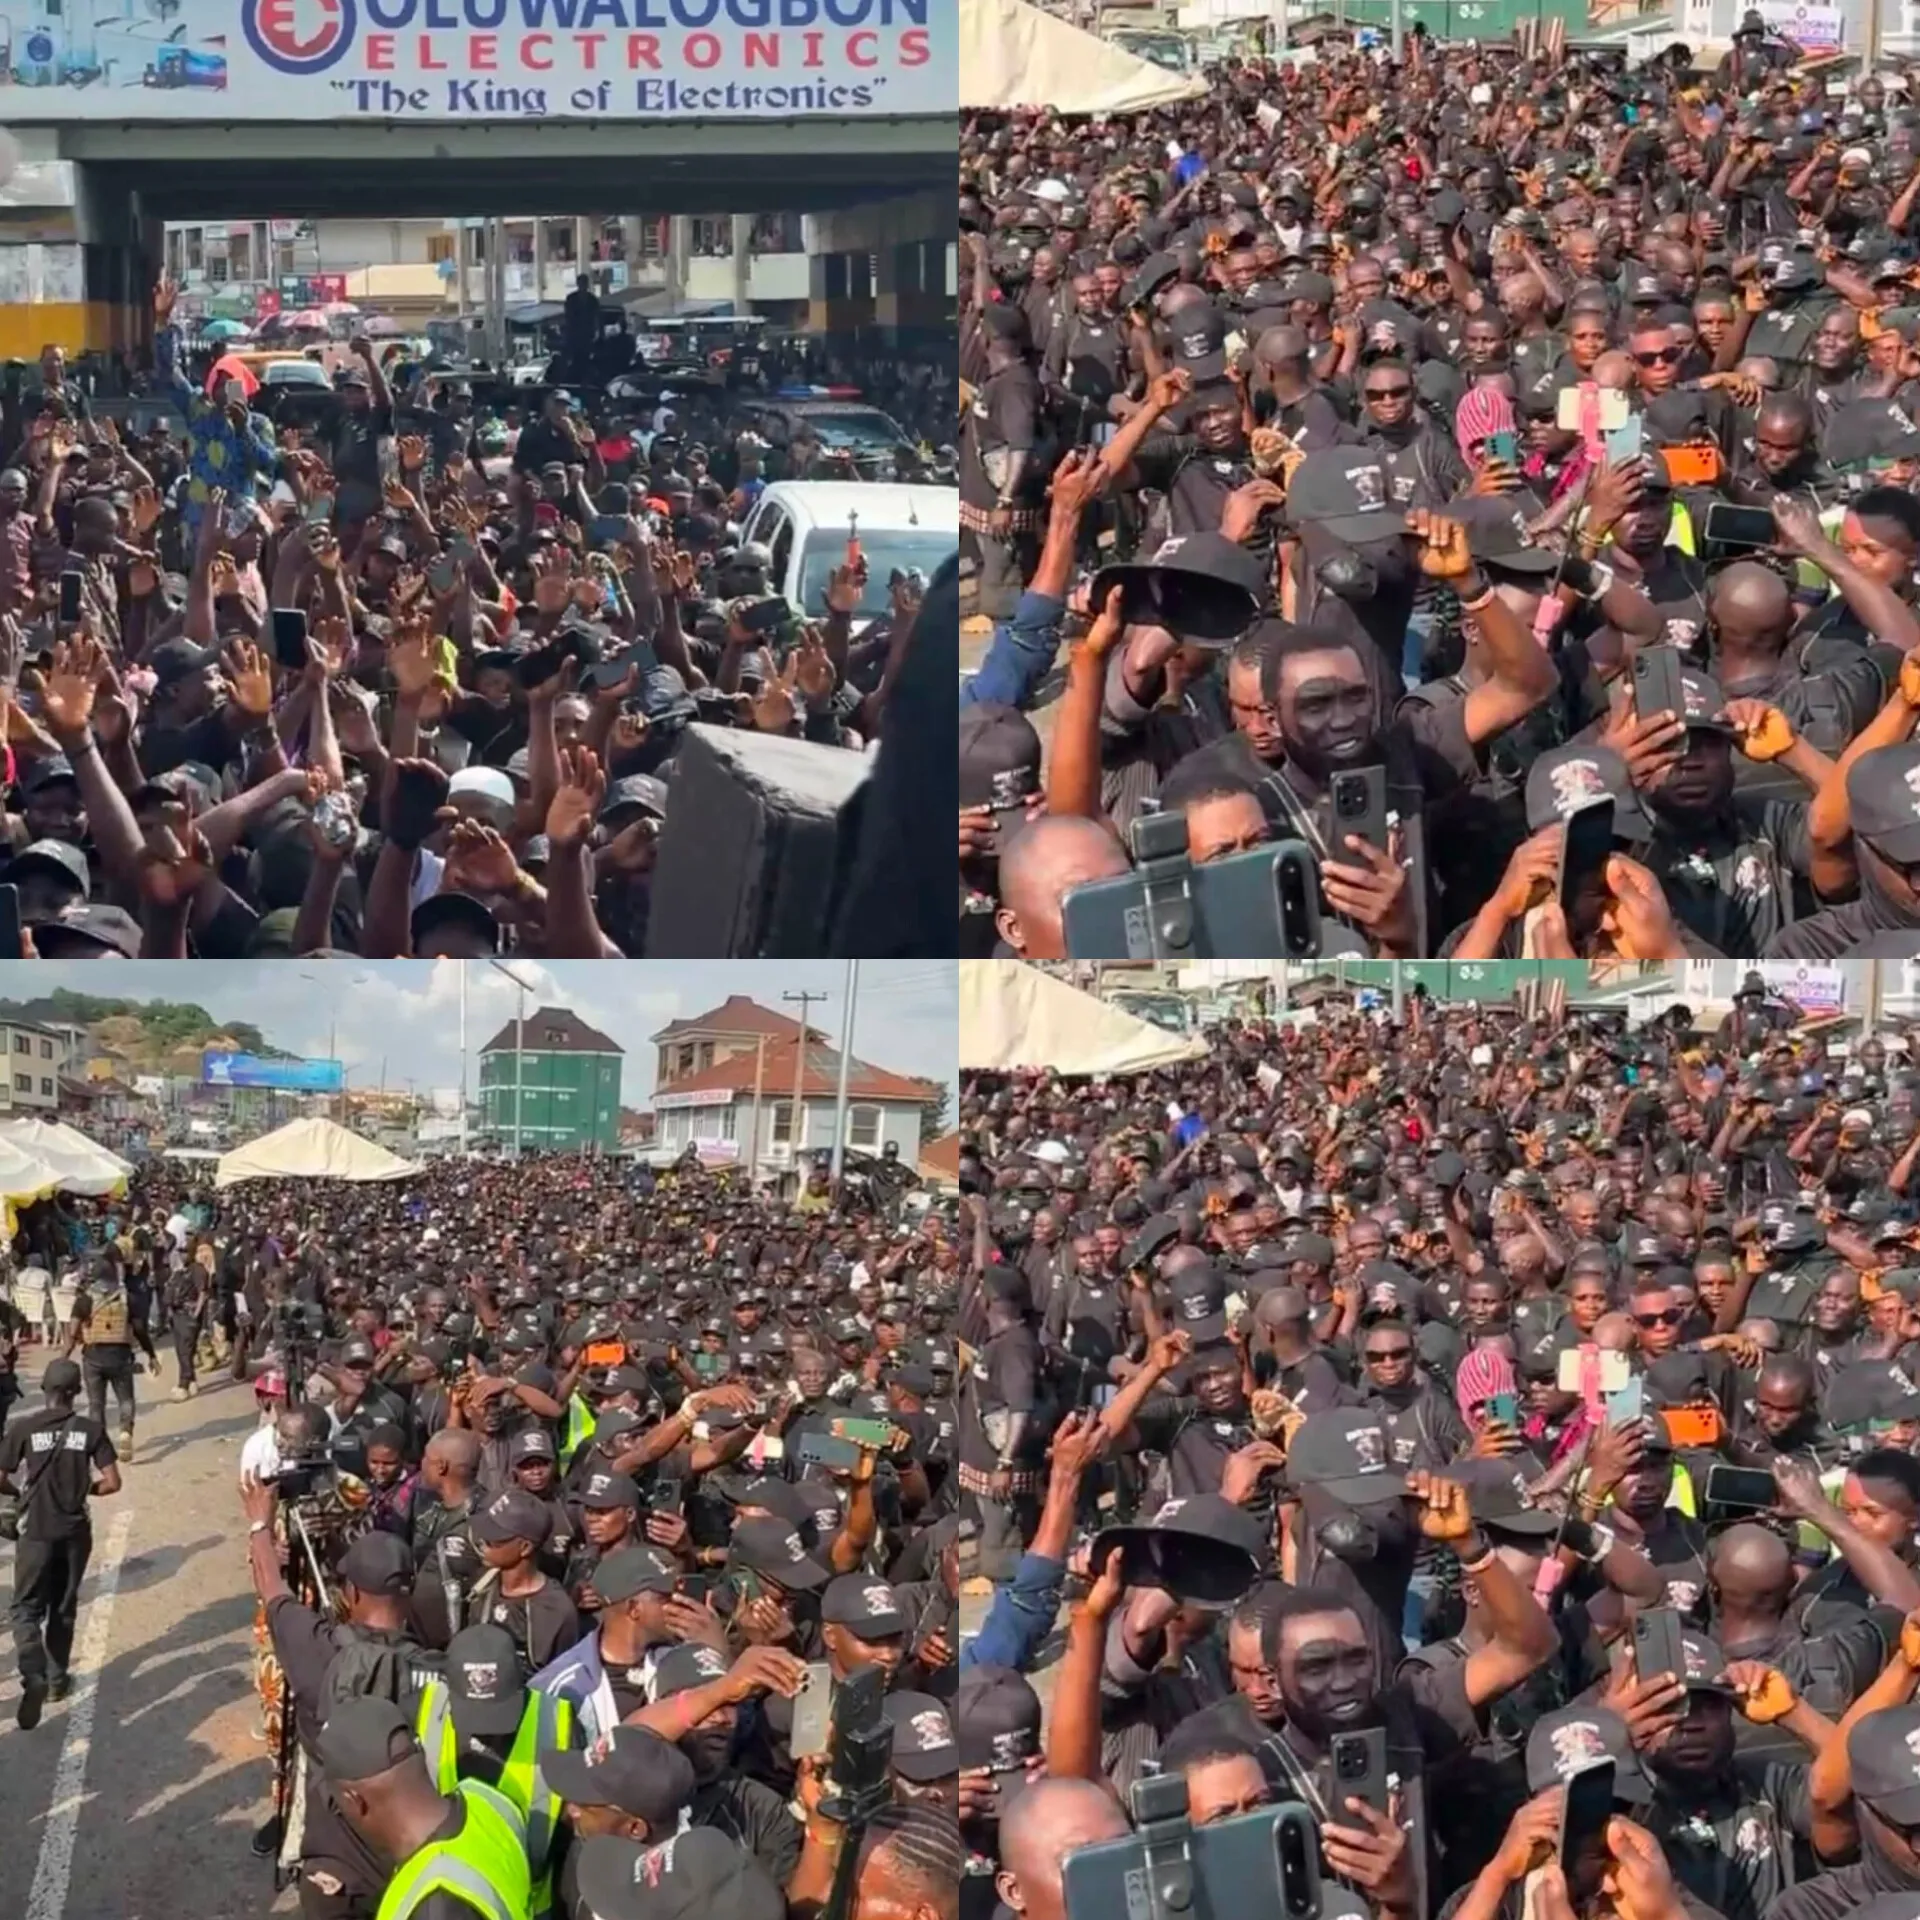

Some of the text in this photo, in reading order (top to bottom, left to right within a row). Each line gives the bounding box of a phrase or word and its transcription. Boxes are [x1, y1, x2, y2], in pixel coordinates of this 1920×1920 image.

[365, 30, 932, 71] ELECTRONICS
[447, 79, 547, 116] King
[570, 80, 612, 111] of
